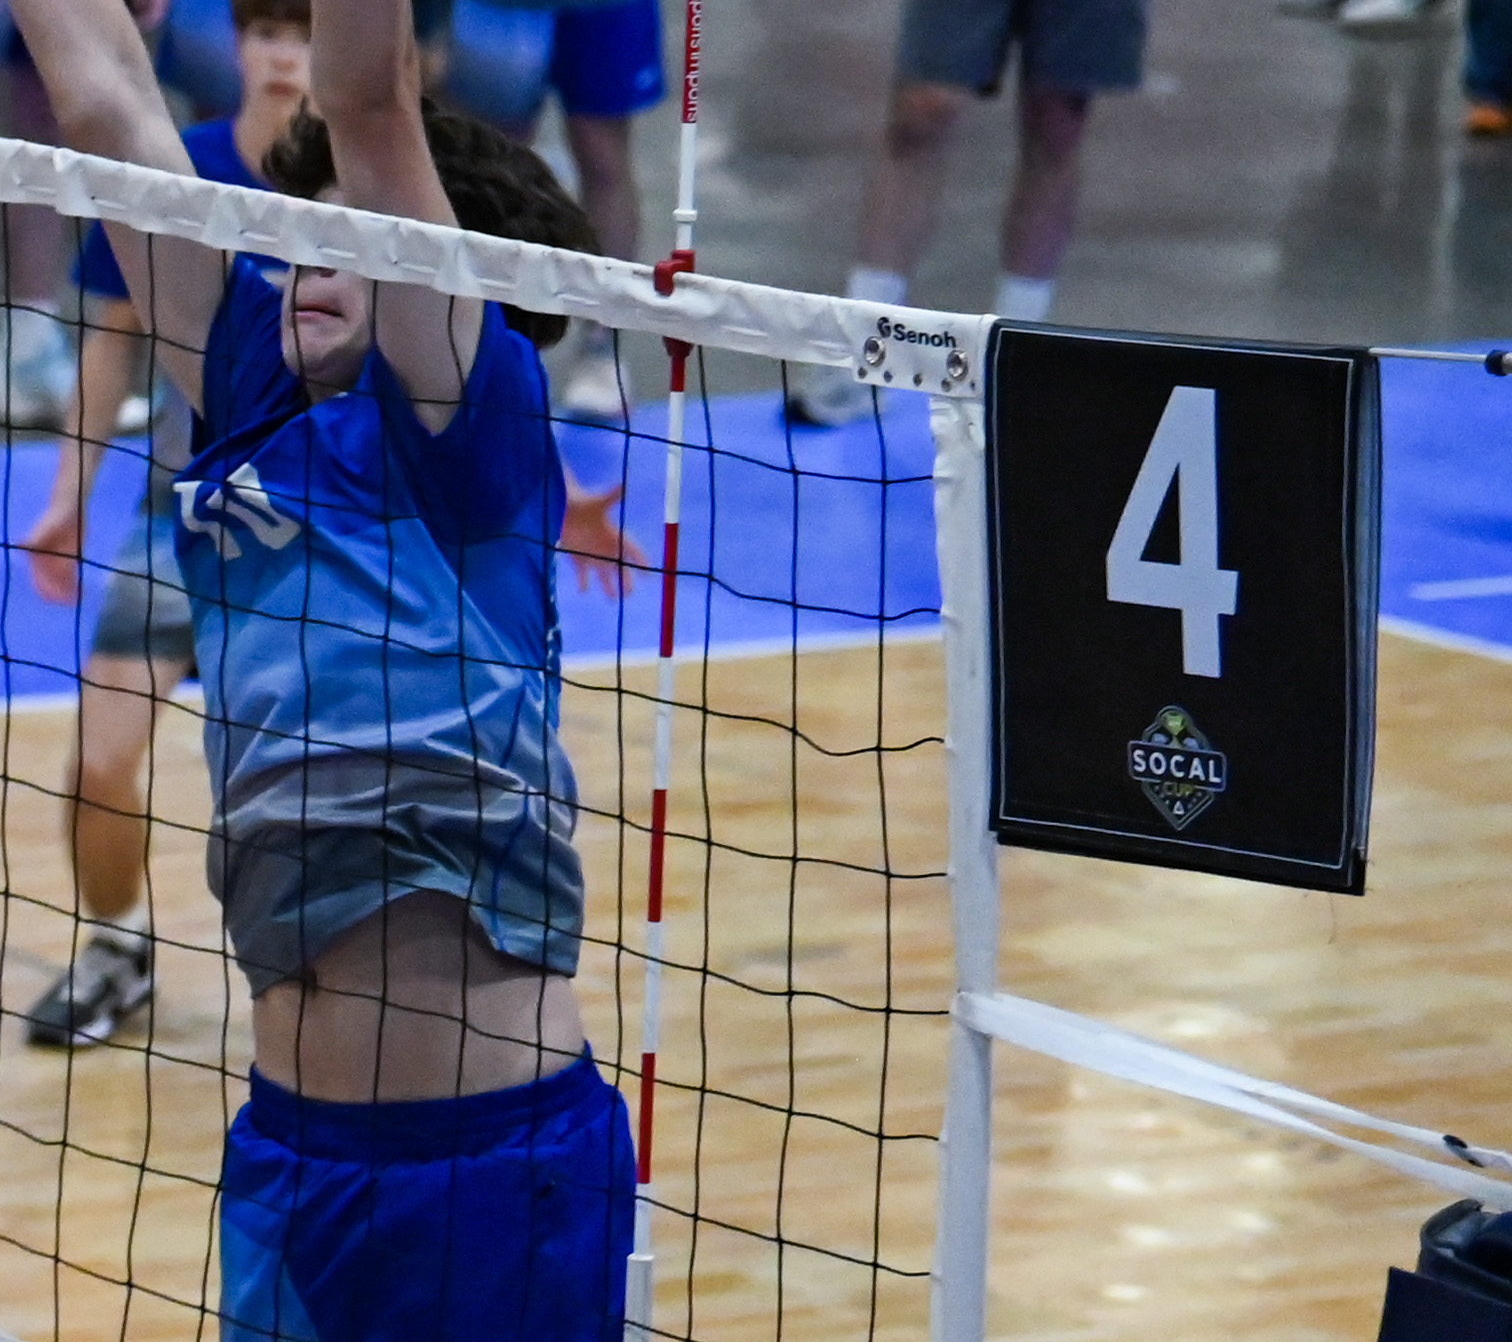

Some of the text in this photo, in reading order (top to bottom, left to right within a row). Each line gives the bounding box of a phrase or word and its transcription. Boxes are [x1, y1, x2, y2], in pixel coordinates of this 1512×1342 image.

[893, 323, 957, 348] Senoh
[1105, 385, 1239, 679] 4
[1132, 749, 1222, 783] SOCAL
